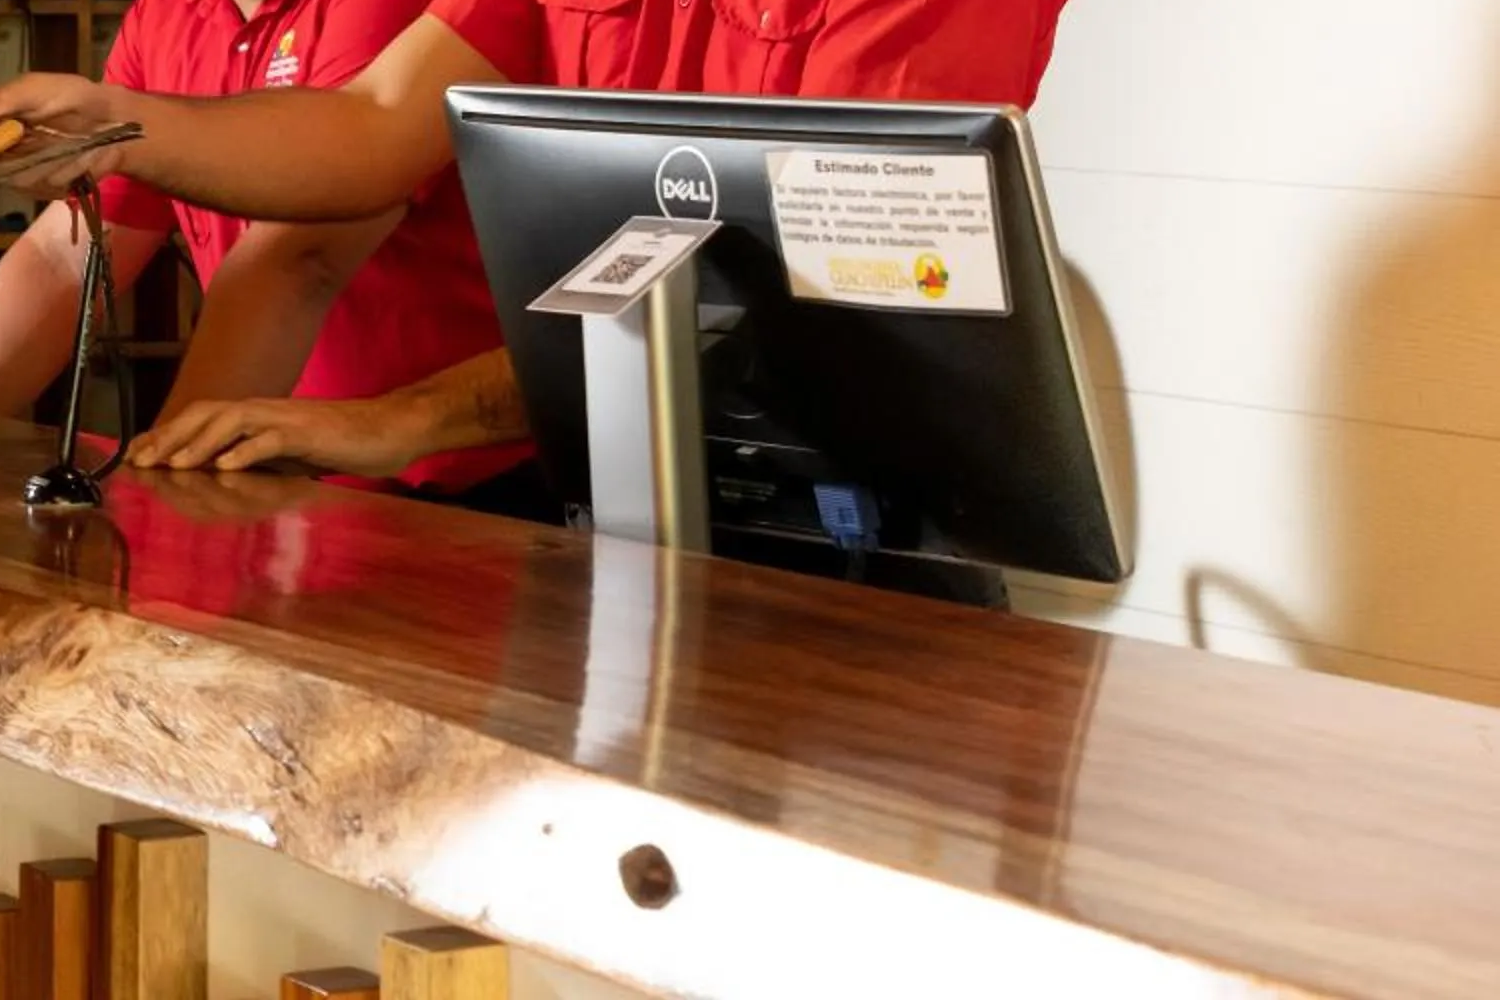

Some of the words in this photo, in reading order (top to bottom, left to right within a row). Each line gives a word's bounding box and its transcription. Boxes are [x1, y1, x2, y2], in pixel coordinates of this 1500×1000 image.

[814, 159, 878, 175] Estimado
[883, 162, 935, 177] Cliente
[662, 177, 711, 202] DELL
